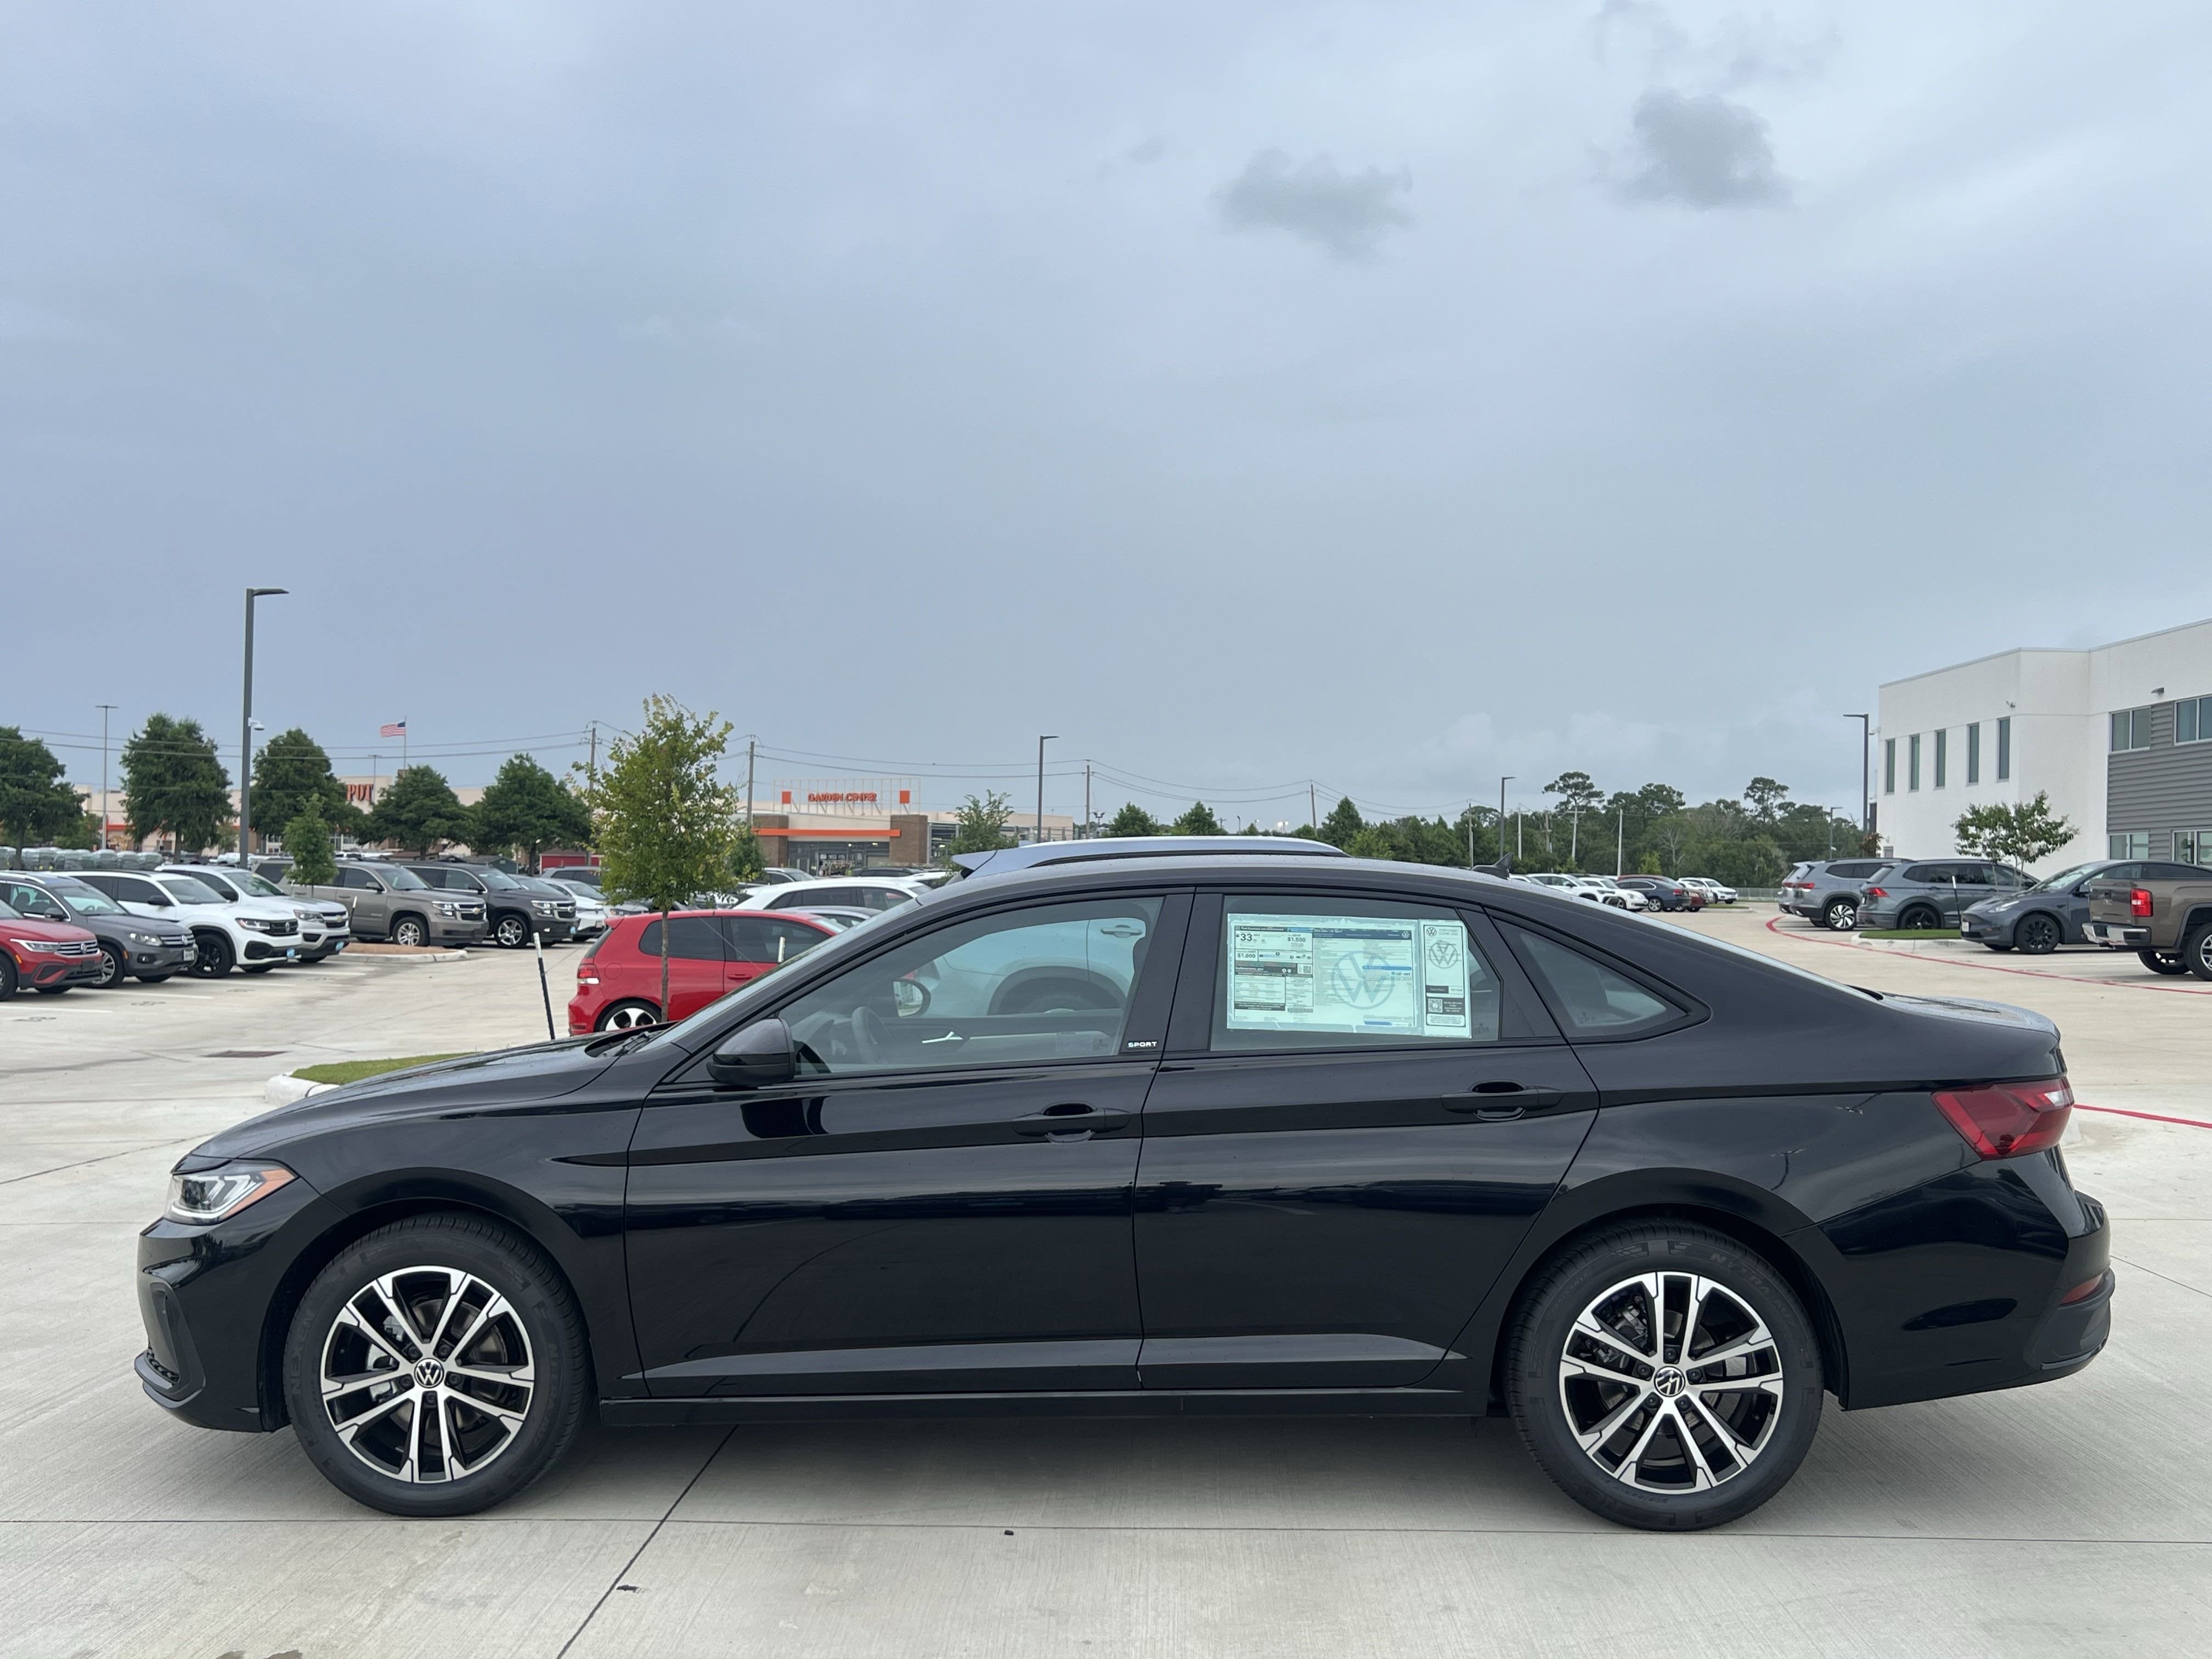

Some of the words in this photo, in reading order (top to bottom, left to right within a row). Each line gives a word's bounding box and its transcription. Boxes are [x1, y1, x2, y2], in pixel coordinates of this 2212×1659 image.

[808, 793, 843, 802] GARDEN
[845, 793, 877, 802] CENTER
[1240, 933, 1252, 941] 33
